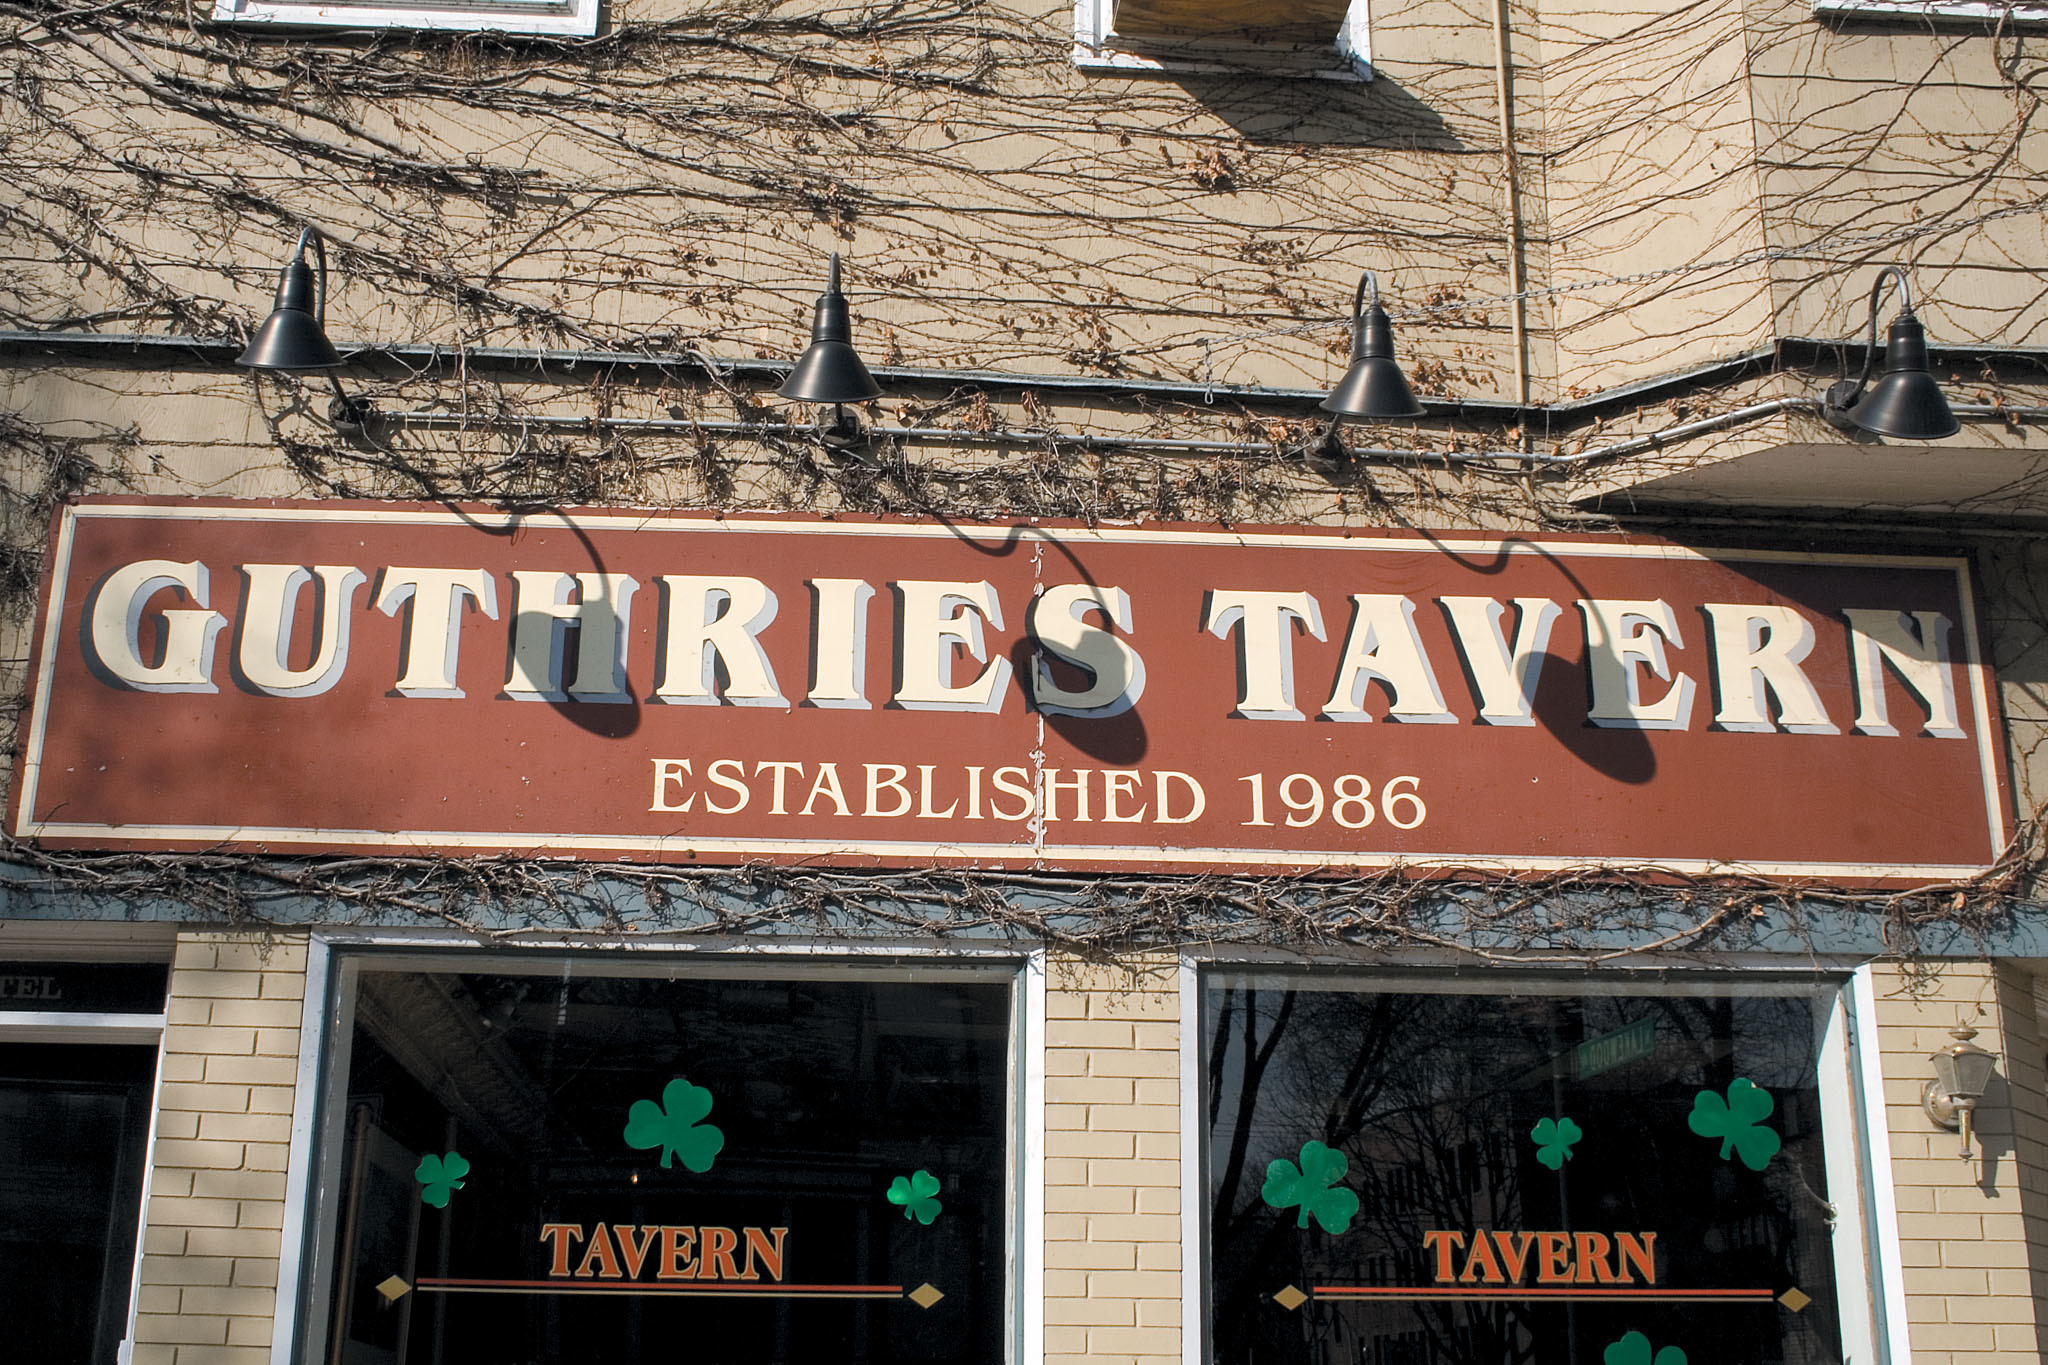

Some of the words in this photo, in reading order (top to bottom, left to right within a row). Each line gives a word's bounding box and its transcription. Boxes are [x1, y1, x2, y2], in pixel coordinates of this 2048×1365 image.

[80, 559, 1147, 719] GUTHRIES
[1202, 588, 1968, 739] TAVERN
[647, 757, 1207, 826] ESTABLISHED
[1238, 772, 1427, 831] 1986
[540, 1221, 789, 1281] TAVERN
[1422, 1228, 1658, 1285] TAVERN
